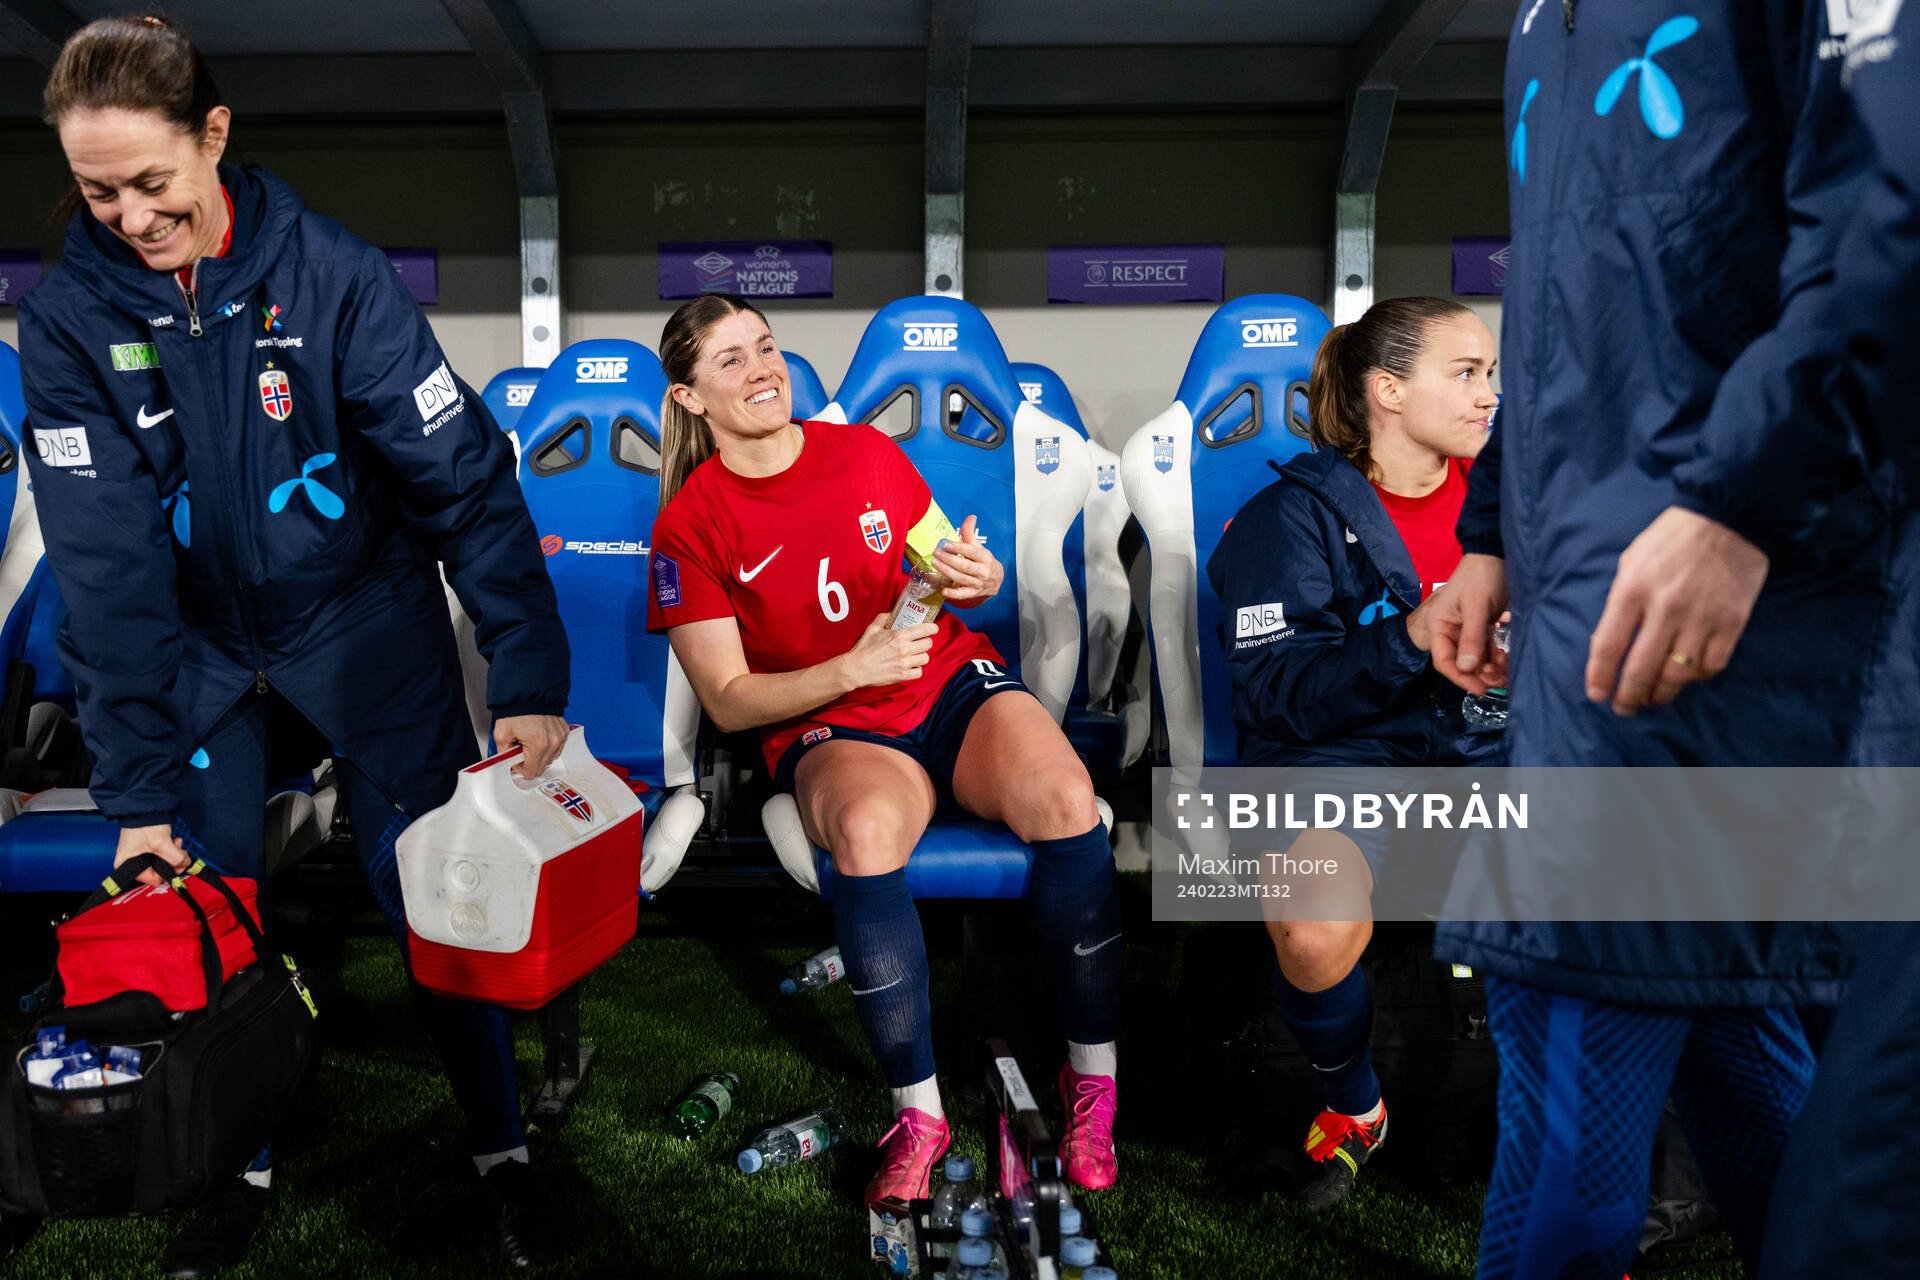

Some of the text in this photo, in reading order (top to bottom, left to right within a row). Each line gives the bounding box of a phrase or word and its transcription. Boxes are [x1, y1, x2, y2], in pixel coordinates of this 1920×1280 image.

[744, 260, 791, 269] women's
[1112, 265, 1188, 281] RESPECT
[736, 271, 798, 282] NATIONS
[740, 283, 795, 295] LEAGUE
[903, 328, 958, 346] OMP
[1241, 324, 1297, 343] OMP
[576, 362, 628, 379] OMP
[817, 557, 849, 623] 6
[1240, 608, 1277, 631] DNB
